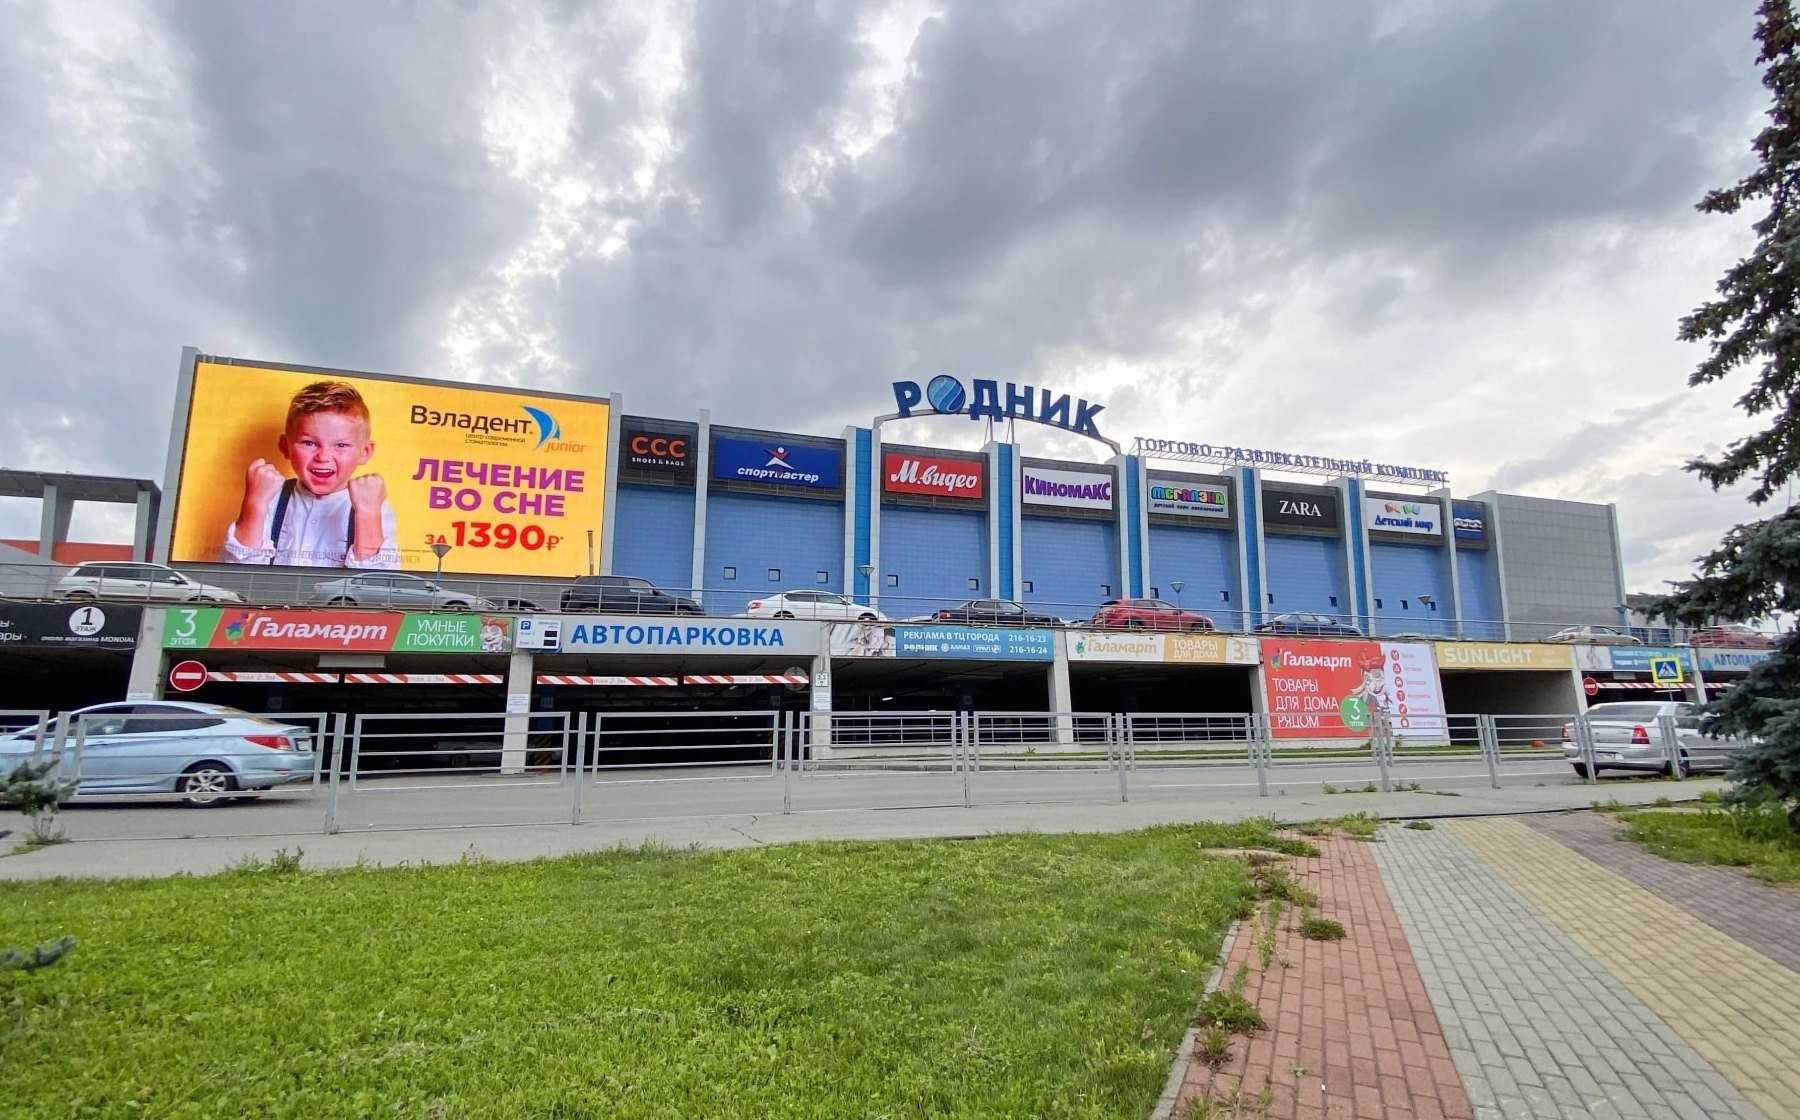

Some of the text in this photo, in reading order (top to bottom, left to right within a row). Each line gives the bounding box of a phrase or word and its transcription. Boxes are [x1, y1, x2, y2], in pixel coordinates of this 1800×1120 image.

[892, 374, 1106, 438] РОДНИК
[410, 405, 533, 434] Вэладент
[544, 440, 586, 453] junior
[631, 436, 686, 458] CCC
[412, 458, 585, 493] ЛЕЧЕНИЕ
[737, 466, 820, 484] спортмастер
[890, 460, 978, 492] М.видео
[1377, 463, 1450, 483] КОМПЛЕКС
[1024, 475, 1111, 501] КИНОМАКС
[429, 486, 566, 517] ВО СНЕ
[1279, 500, 1322, 518] ZARA
[1374, 514, 1434, 532] Детский мир
[80, 608, 93, 625] 1
[176, 609, 198, 637] 3
[250, 616, 388, 645] Галамарт
[417, 620, 468, 633] УМНЫЕ
[571, 624, 784, 647] АВТОПАРКОВКА
[406, 633, 475, 647] ПОКУПКИ
[903, 631, 945, 640] РЕКЛАМА
[954, 632, 965, 643] ТЦ
[966, 633, 1000, 642] ГОРОДА
[1008, 634, 1047, 643] 216-16-23
[1172, 639, 1218, 650] ТОВАРЫ
[1009, 645, 1048, 654] 216-16-24
[1087, 638, 1157, 657] Галамарт
[1173, 650, 1218, 660] ДЛЯ ДОМА
[1444, 647, 1532, 664] SUNLIGHT
[1283, 651, 1352, 672] Галамарт
[1272, 677, 1319, 693] ТОВАРЫ
[1276, 695, 1340, 711] ДЛЯ ДОМА
[1349, 698, 1361, 720] 3
